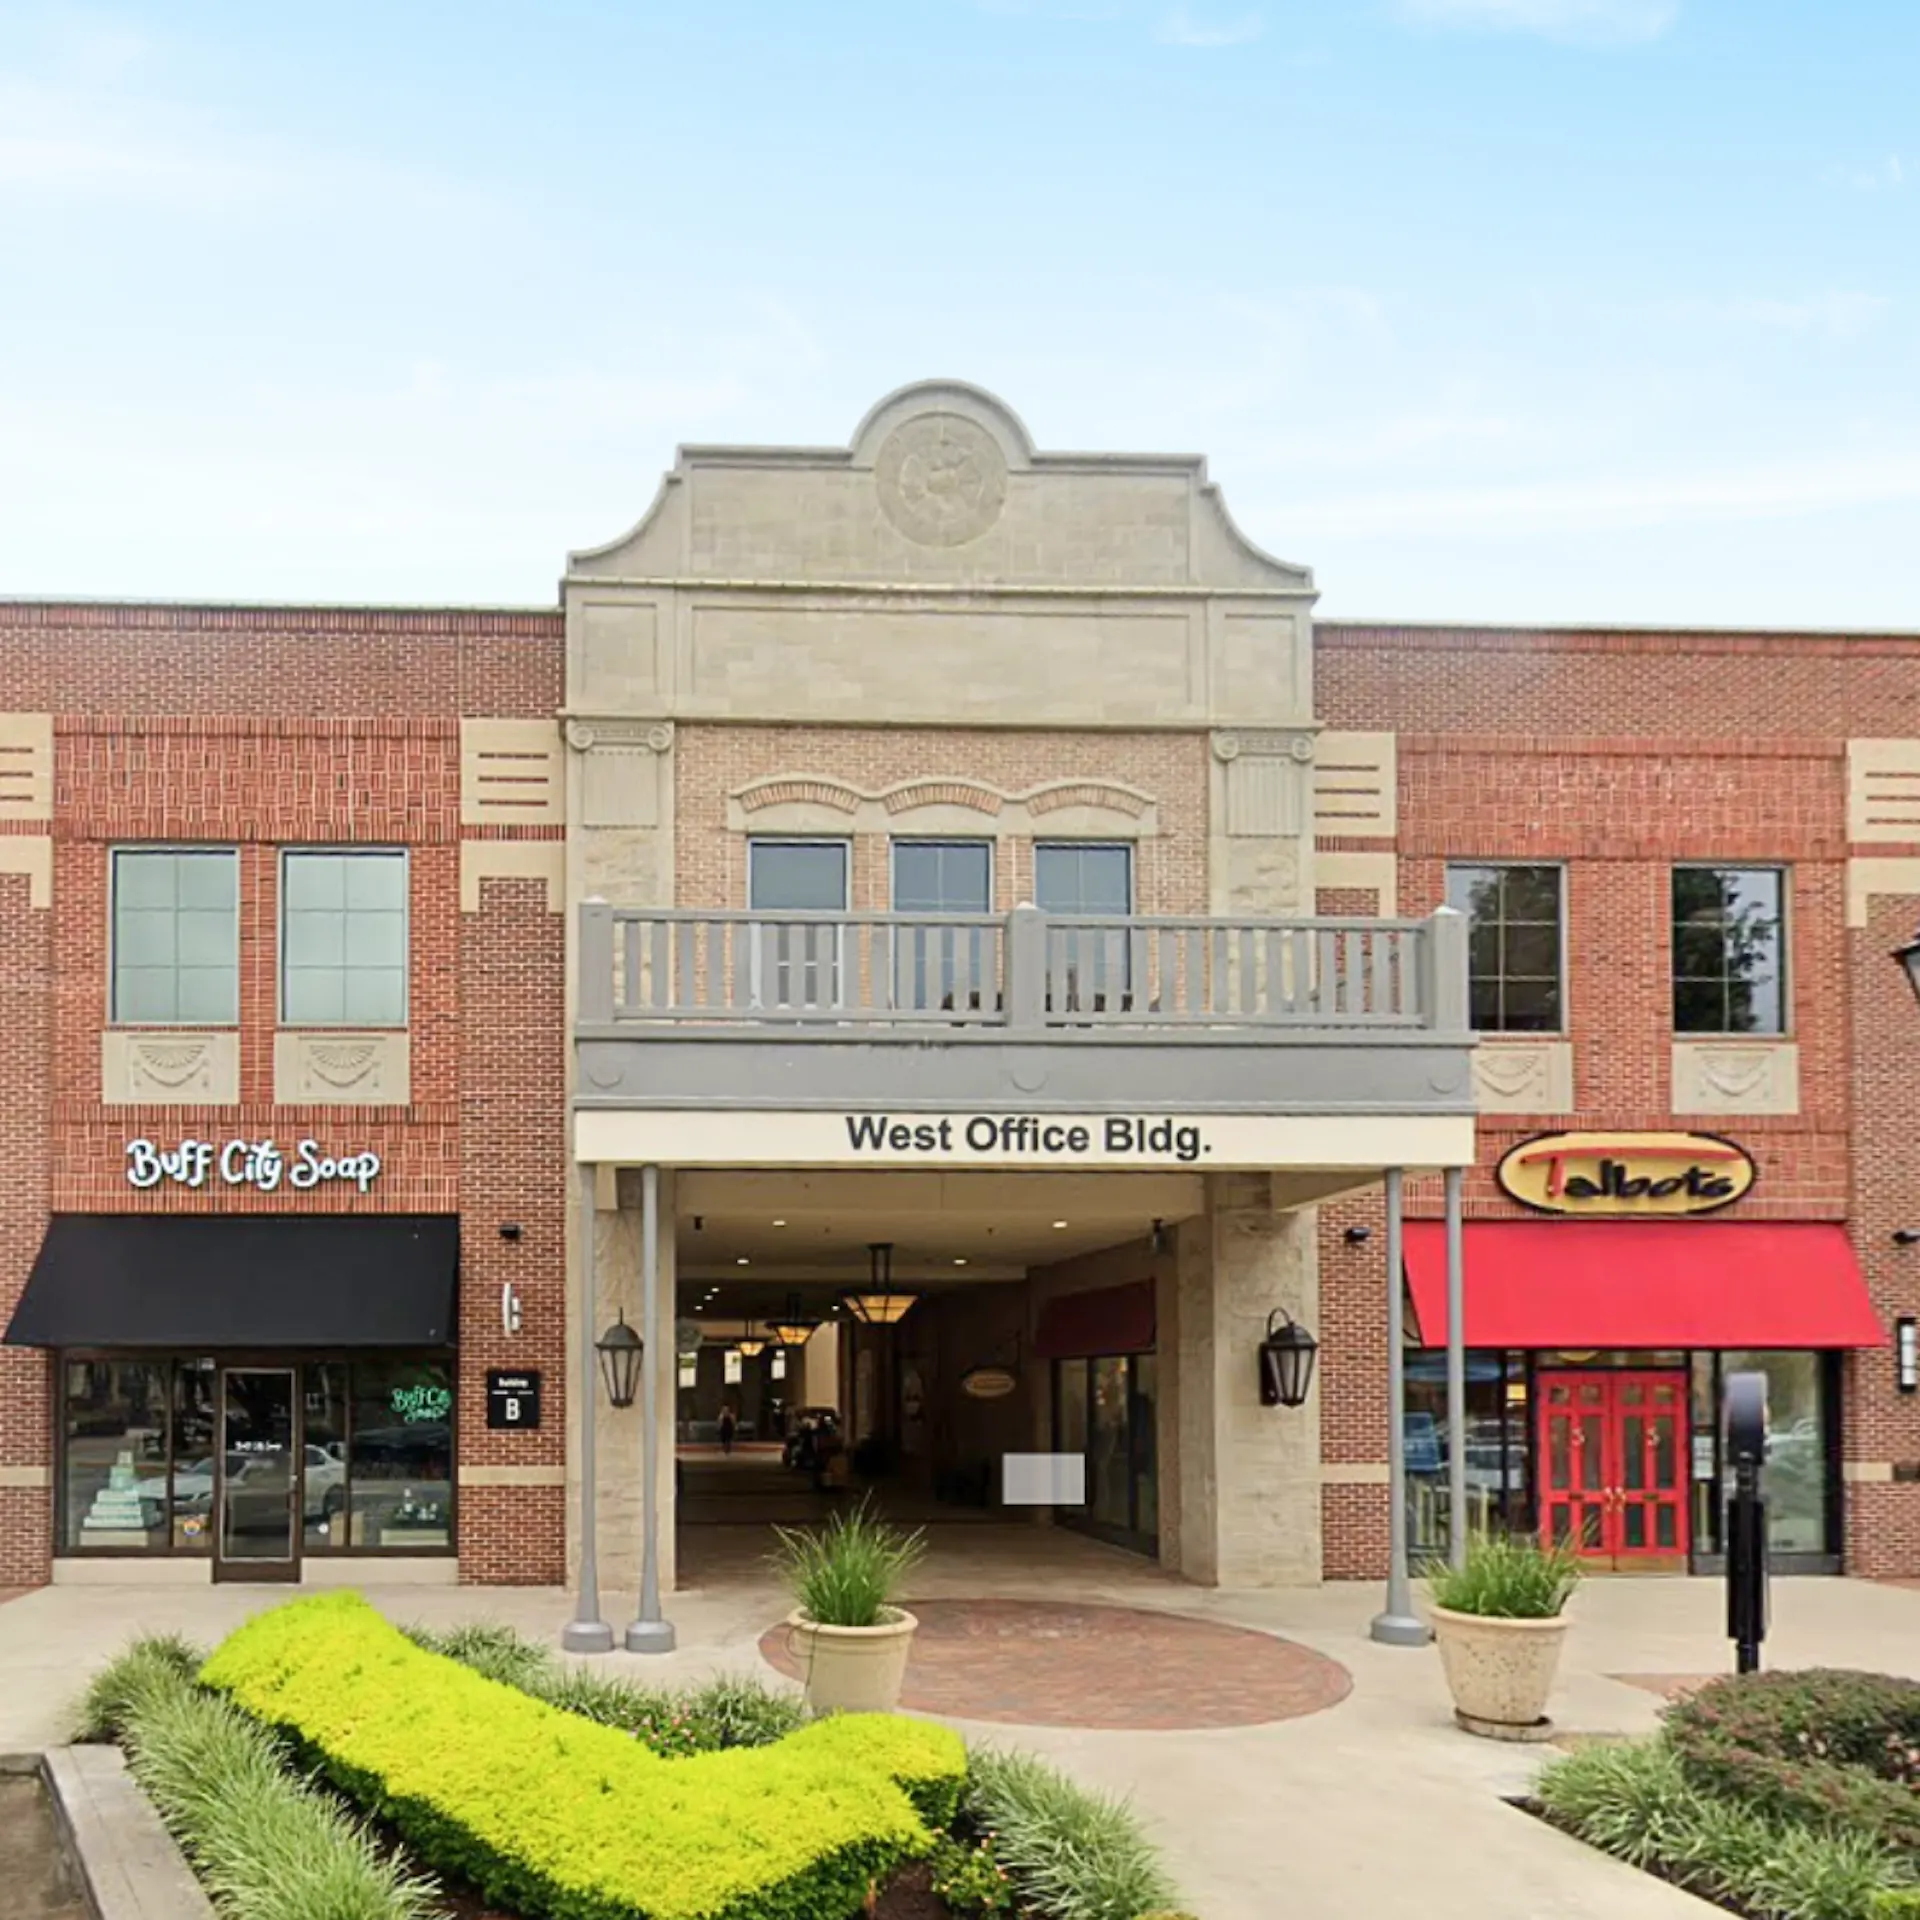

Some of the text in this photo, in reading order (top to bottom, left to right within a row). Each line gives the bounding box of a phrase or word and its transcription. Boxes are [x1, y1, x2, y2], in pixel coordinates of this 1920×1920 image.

[846, 1116, 1212, 1161] West Office Bldg.
[126, 1138, 380, 1193] Buff City Soap
[1519, 1146, 1741, 1198] Talbots
[505, 1398, 520, 1420] B
